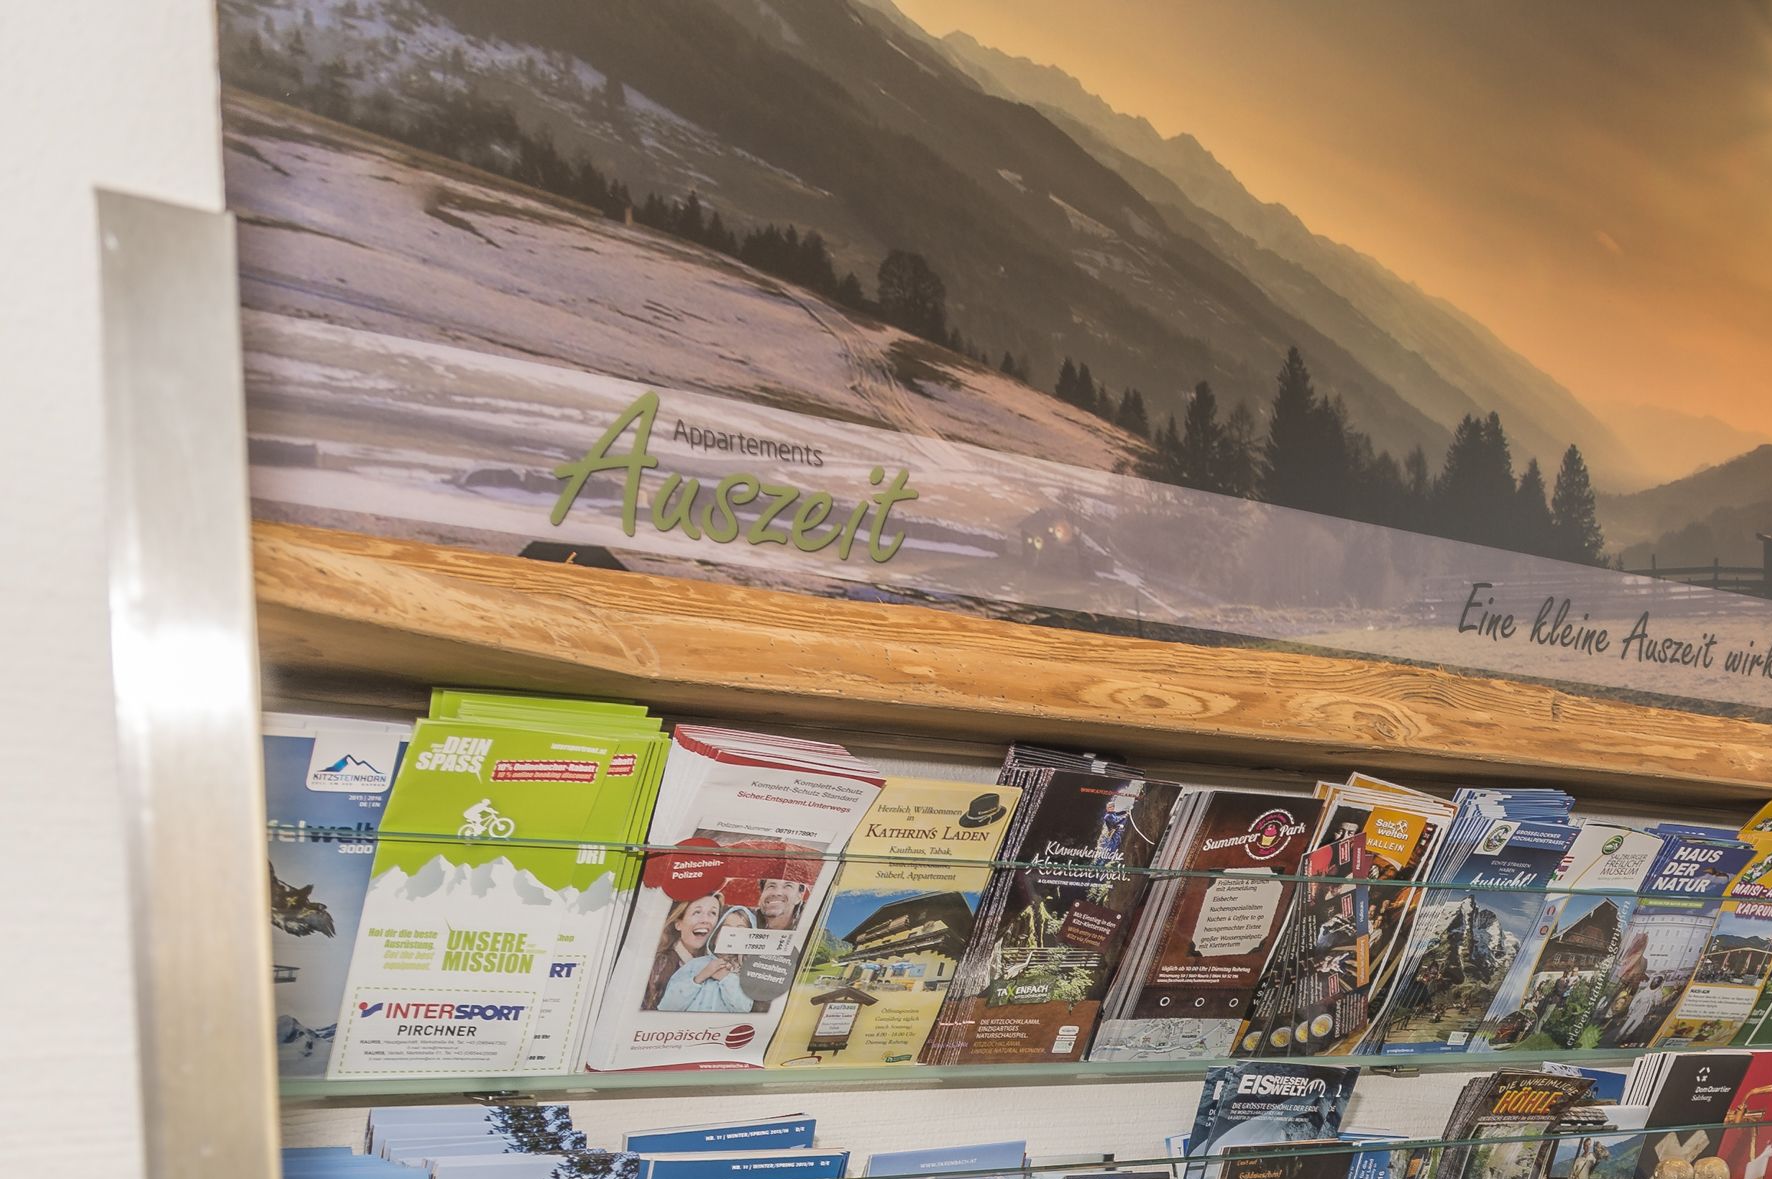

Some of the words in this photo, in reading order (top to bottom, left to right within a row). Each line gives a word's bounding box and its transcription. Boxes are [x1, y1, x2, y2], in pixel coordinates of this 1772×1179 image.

[674, 419, 824, 467] Appartements
[550, 390, 919, 563] Auszeit
[1459, 583, 1517, 642] Eine
[1530, 596, 1610, 656] kleine
[1621, 611, 1717, 669] Auszeit
[443, 736, 493, 755] DEIN
[416, 752, 485, 773] SPASS
[313, 774, 387, 782] KITZSTEINHORN
[751, 780, 820, 797] Komplett-Schutz
[822, 791, 859, 803] Standard
[794, 779, 864, 796] Komplett+Schutz
[878, 805, 911, 814] Herzlich
[914, 805, 963, 816] Willkommen
[1375, 819, 1395, 829] Salz
[1203, 832, 1261, 852] Summerer
[1280, 822, 1306, 838] Park
[1377, 828, 1409, 841] welten
[338, 845, 373, 854] 3000
[889, 846, 927, 855] Kaufhaus,
[1366, 839, 1405, 852] HALLEIN
[1674, 847, 1724, 863] HAUS
[673, 859, 724, 870] Zahlschein-
[1605, 859, 1644, 868] FREILICHT
[1663, 862, 1700, 877] DER
[672, 871, 703, 879] Polizze
[875, 870, 905, 880] Stüberl,
[906, 871, 956, 881] Appartement
[1600, 866, 1639, 876] MUSEUM
[1652, 878, 1712, 893] NATUR
[1213, 895, 1239, 903] Eisbecher
[1207, 915, 1226, 923] Kuchen
[368, 928, 381, 937] Hol
[382, 929, 397, 938] dir
[399, 929, 412, 939] die
[414, 930, 438, 939] beste
[447, 930, 528, 953] UNSERE
[442, 952, 534, 974] MISSION
[746, 970, 784, 984] versichert!
[997, 984, 1049, 1000] TAXENBACH
[386, 1003, 525, 1020] INTERSPORT
[397, 1025, 476, 1037] PIRCHNER
[634, 1029, 721, 1043] Europäische
[1238, 1075, 1274, 1095] EIS
[1275, 1076, 1309, 1086] RIESEN
[1499, 1081, 1518, 1093] DIE
[1520, 1078, 1579, 1096] UNHEIMLICHE
[1272, 1085, 1305, 1097] WELT
[1695, 1086, 1731, 1094] DomQuartier
[1493, 1087, 1564, 1115] HÖHLE
